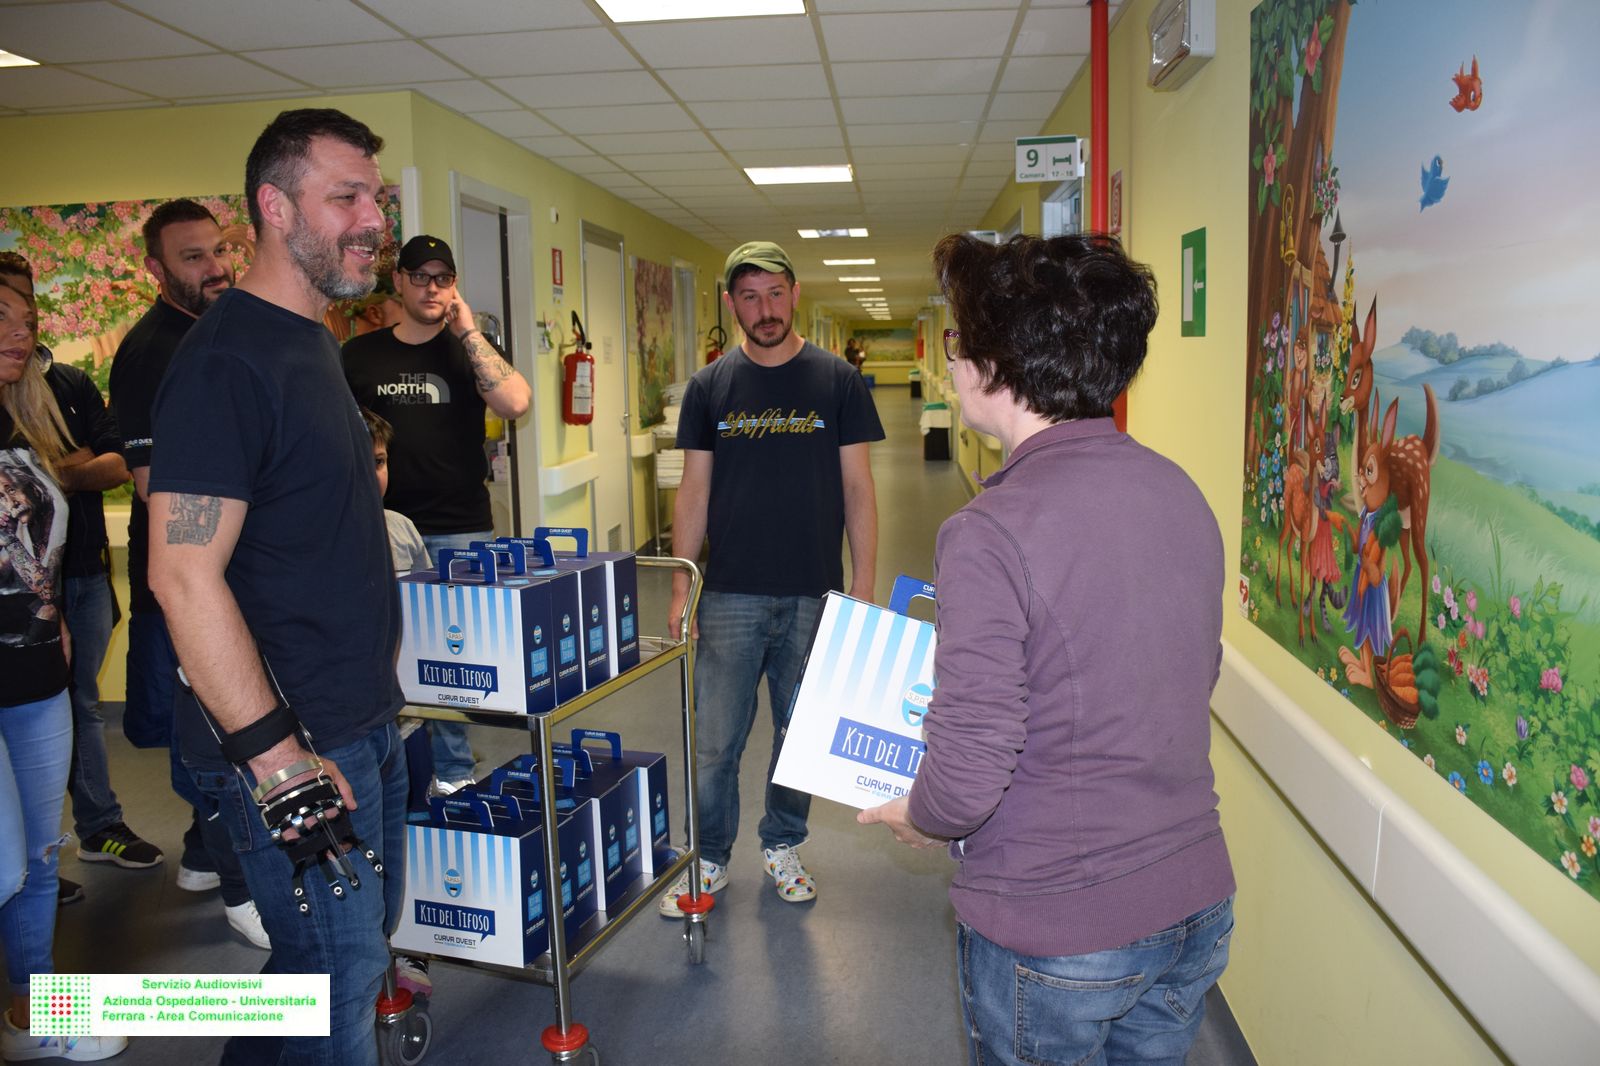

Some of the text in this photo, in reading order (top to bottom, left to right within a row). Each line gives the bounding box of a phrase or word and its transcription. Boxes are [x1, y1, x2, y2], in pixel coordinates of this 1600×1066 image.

[1026, 149, 1039, 168] 9
[399, 373, 425, 384] THE
[377, 383, 425, 396] NORTH
[391, 394, 425, 405] FACE
[721, 408, 819, 439] Diffidati
[857, 775, 892, 794] CURVA
